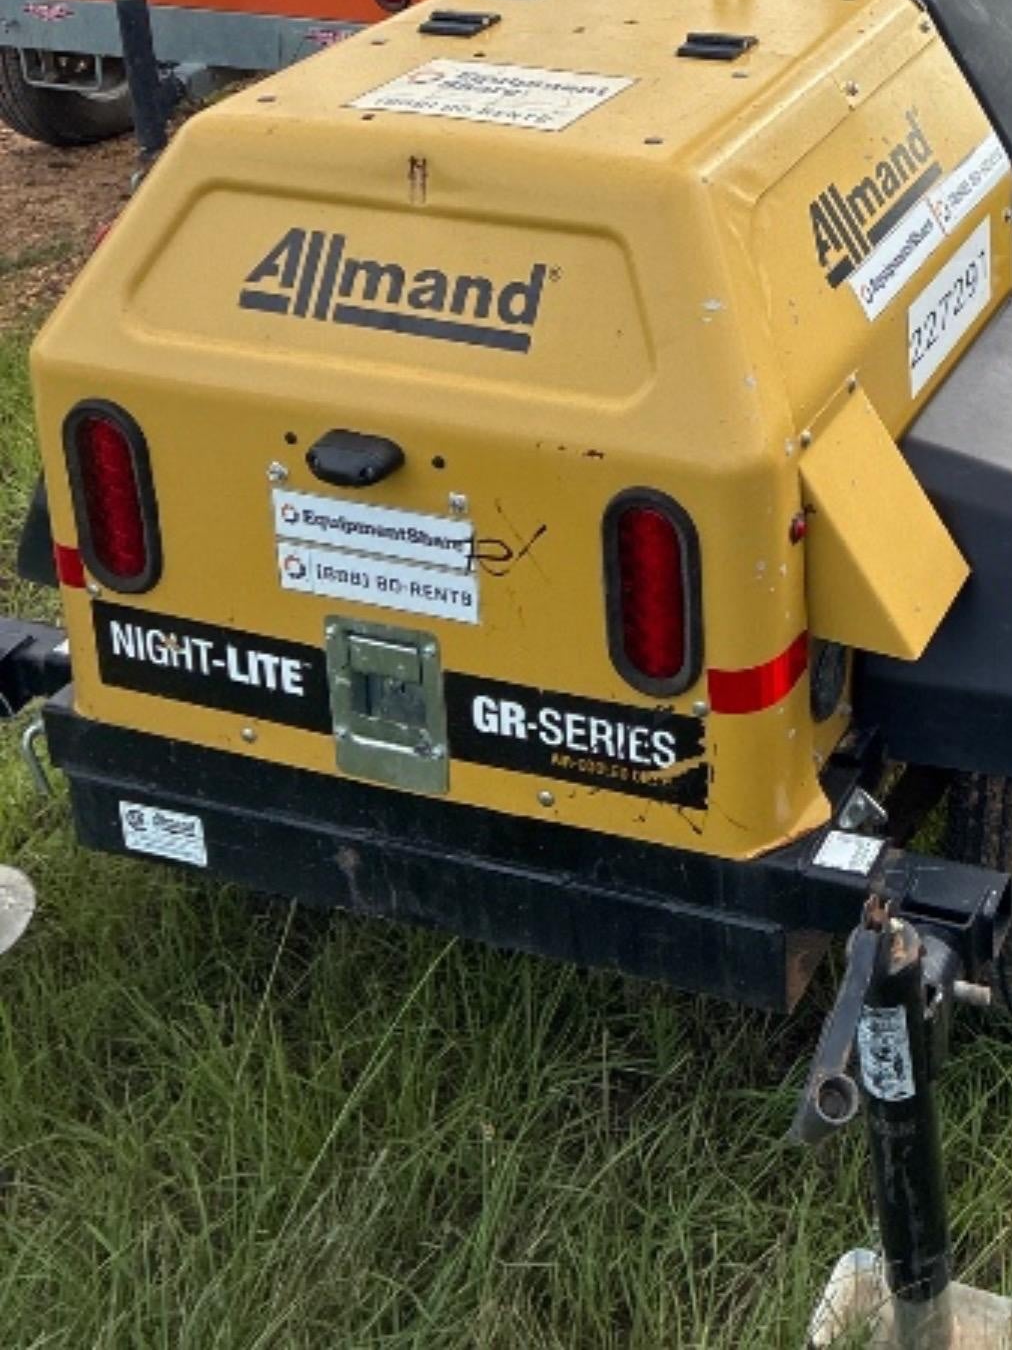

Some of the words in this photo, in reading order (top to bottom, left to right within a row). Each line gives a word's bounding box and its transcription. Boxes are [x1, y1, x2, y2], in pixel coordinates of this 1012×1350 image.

[809, 105, 934, 267] Allmand
[243, 227, 548, 326] Allmand
[109, 620, 304, 697] NIGHT-LITE
[472, 694, 677, 769] GR-SERIES
